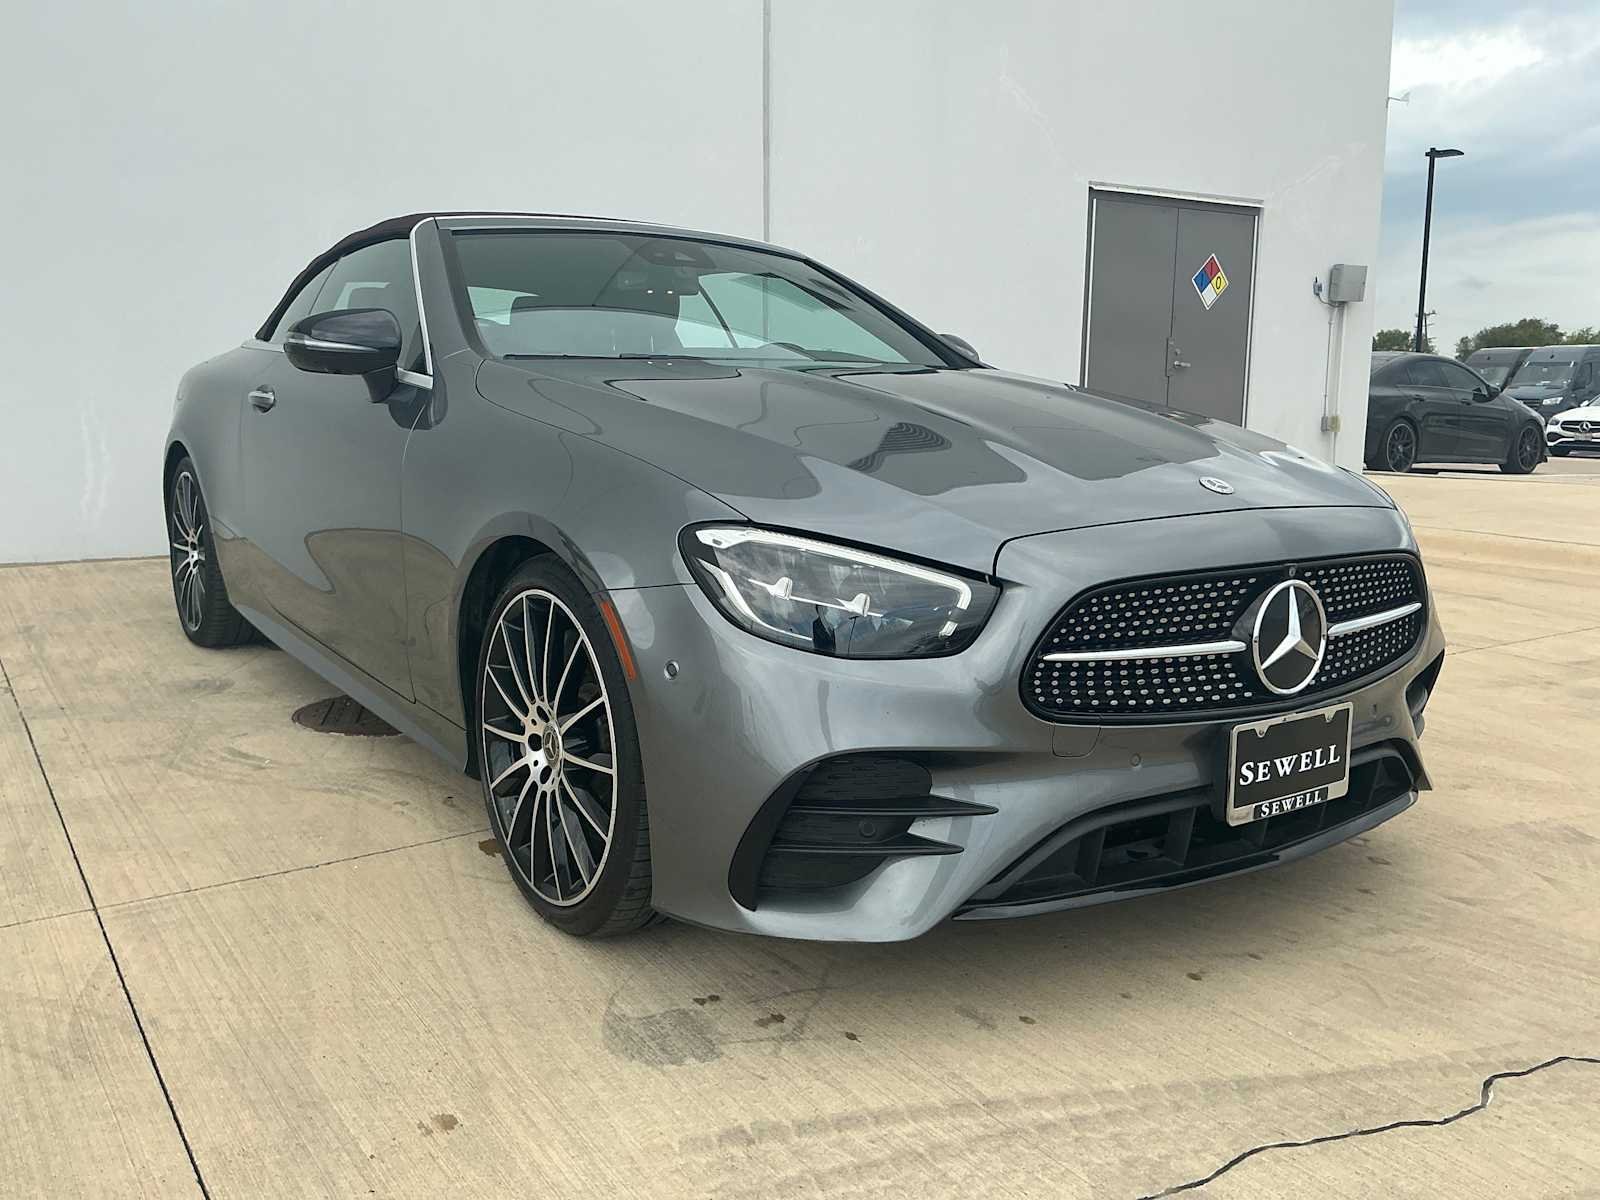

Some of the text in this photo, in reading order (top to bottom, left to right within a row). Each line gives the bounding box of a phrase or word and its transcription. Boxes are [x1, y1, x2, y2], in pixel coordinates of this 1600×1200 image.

[1216, 276, 1222, 290] 0
[1240, 744, 1340, 786] SEWELL
[1260, 790, 1321, 817] SEWELL
